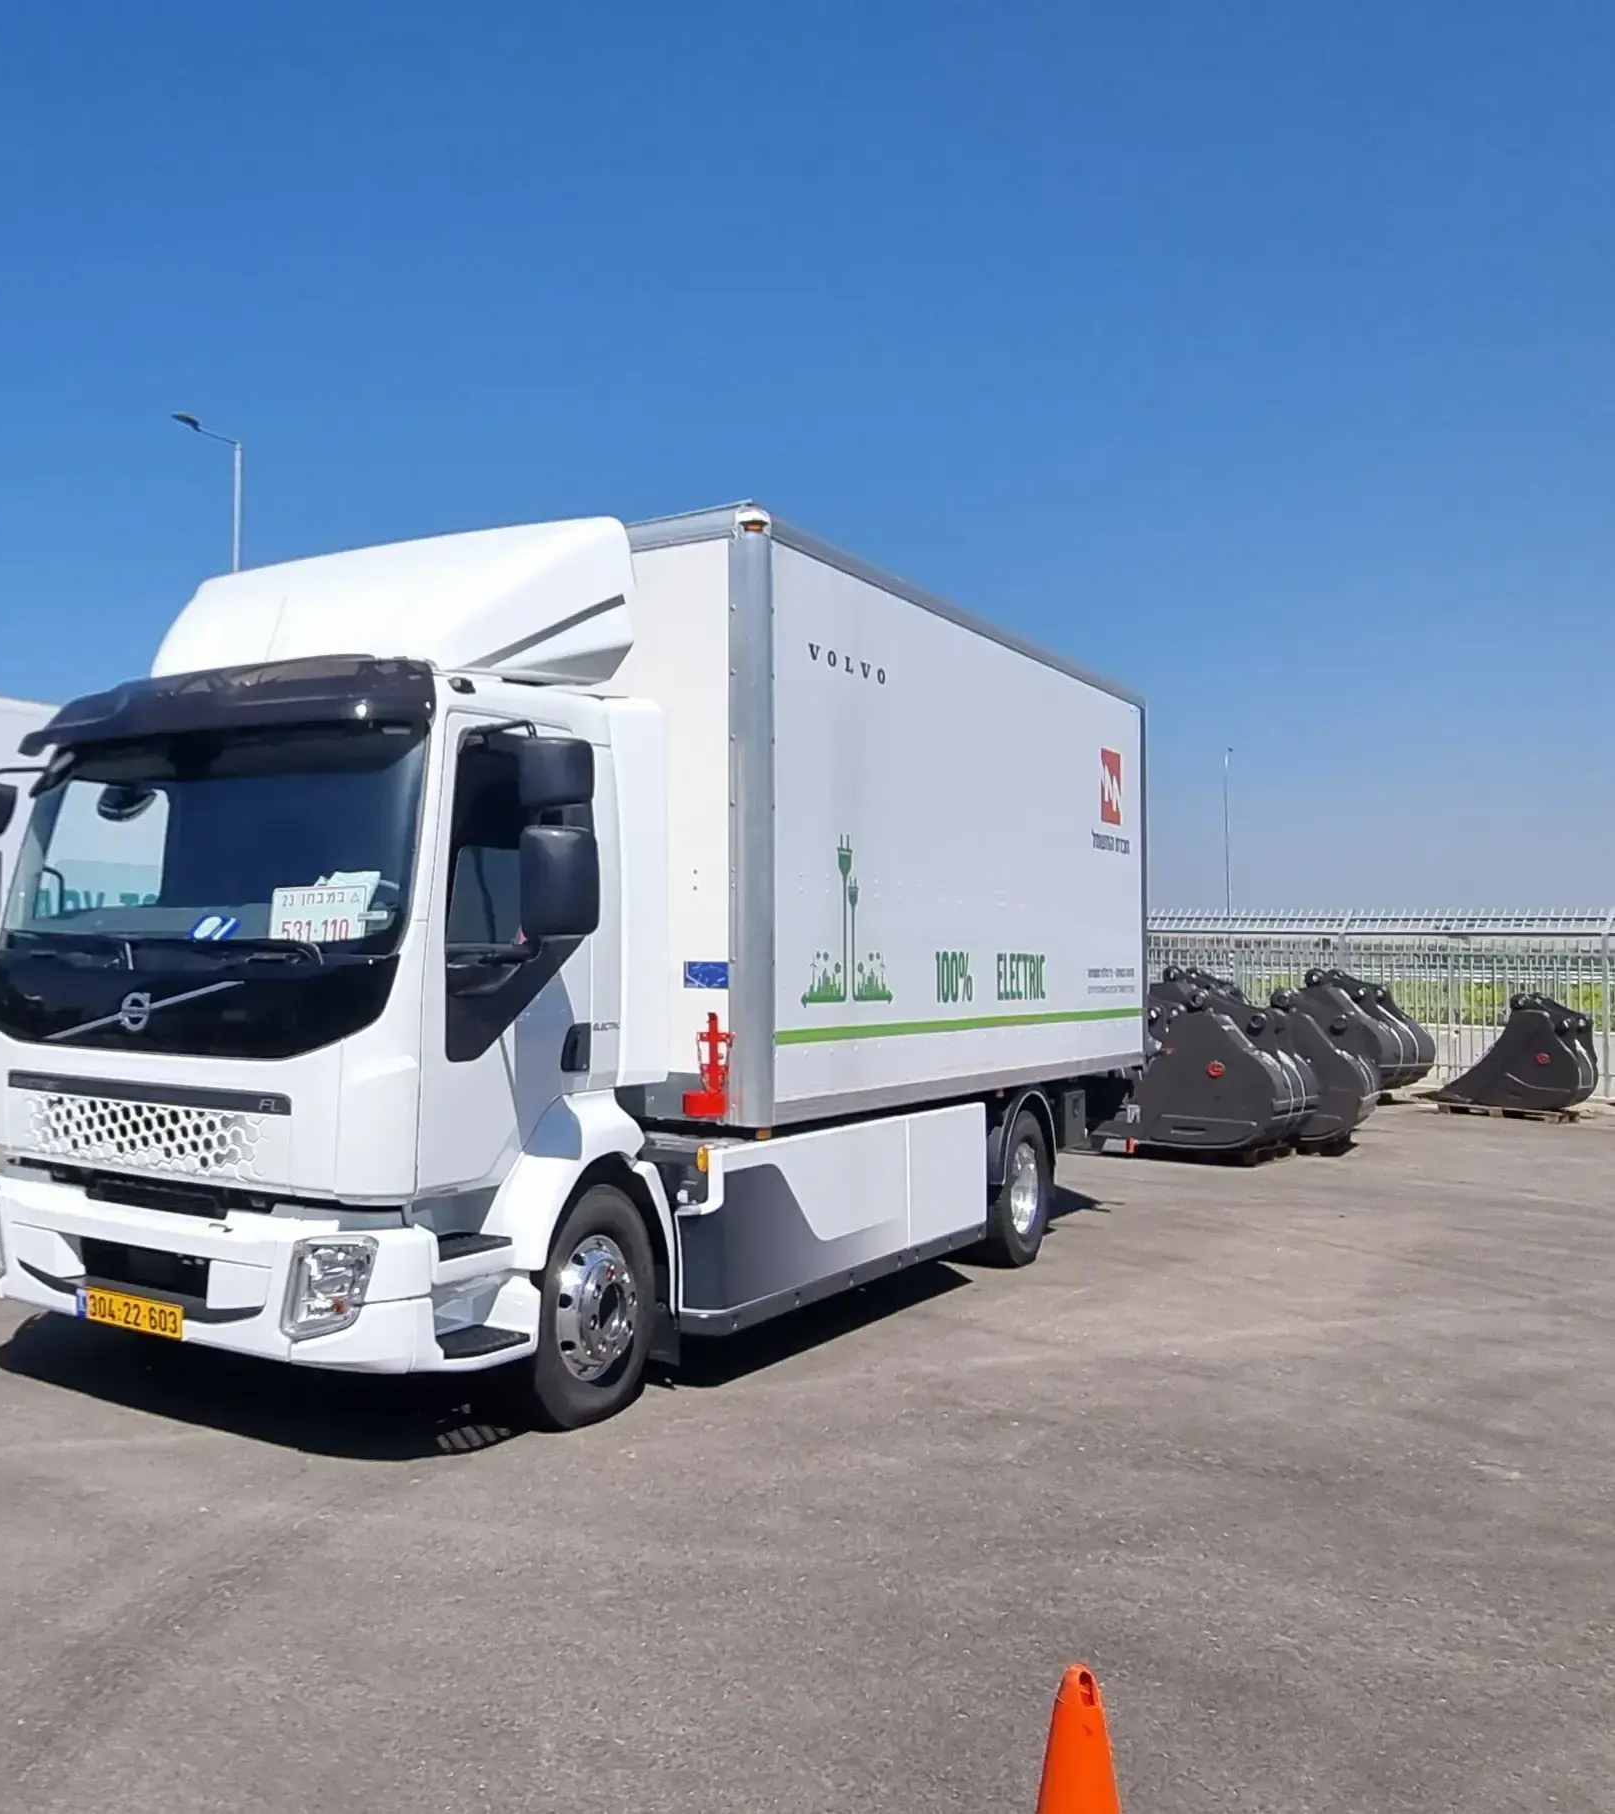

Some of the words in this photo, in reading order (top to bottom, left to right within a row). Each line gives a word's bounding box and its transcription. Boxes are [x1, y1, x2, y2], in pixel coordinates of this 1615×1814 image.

[808, 642, 886, 685] VOLVO
[302, 891, 345, 906] במבחן
[935, 951, 973, 1003] 100%
[997, 953, 1046, 1001] ELECTRIC
[259, 1099, 283, 1112] FL
